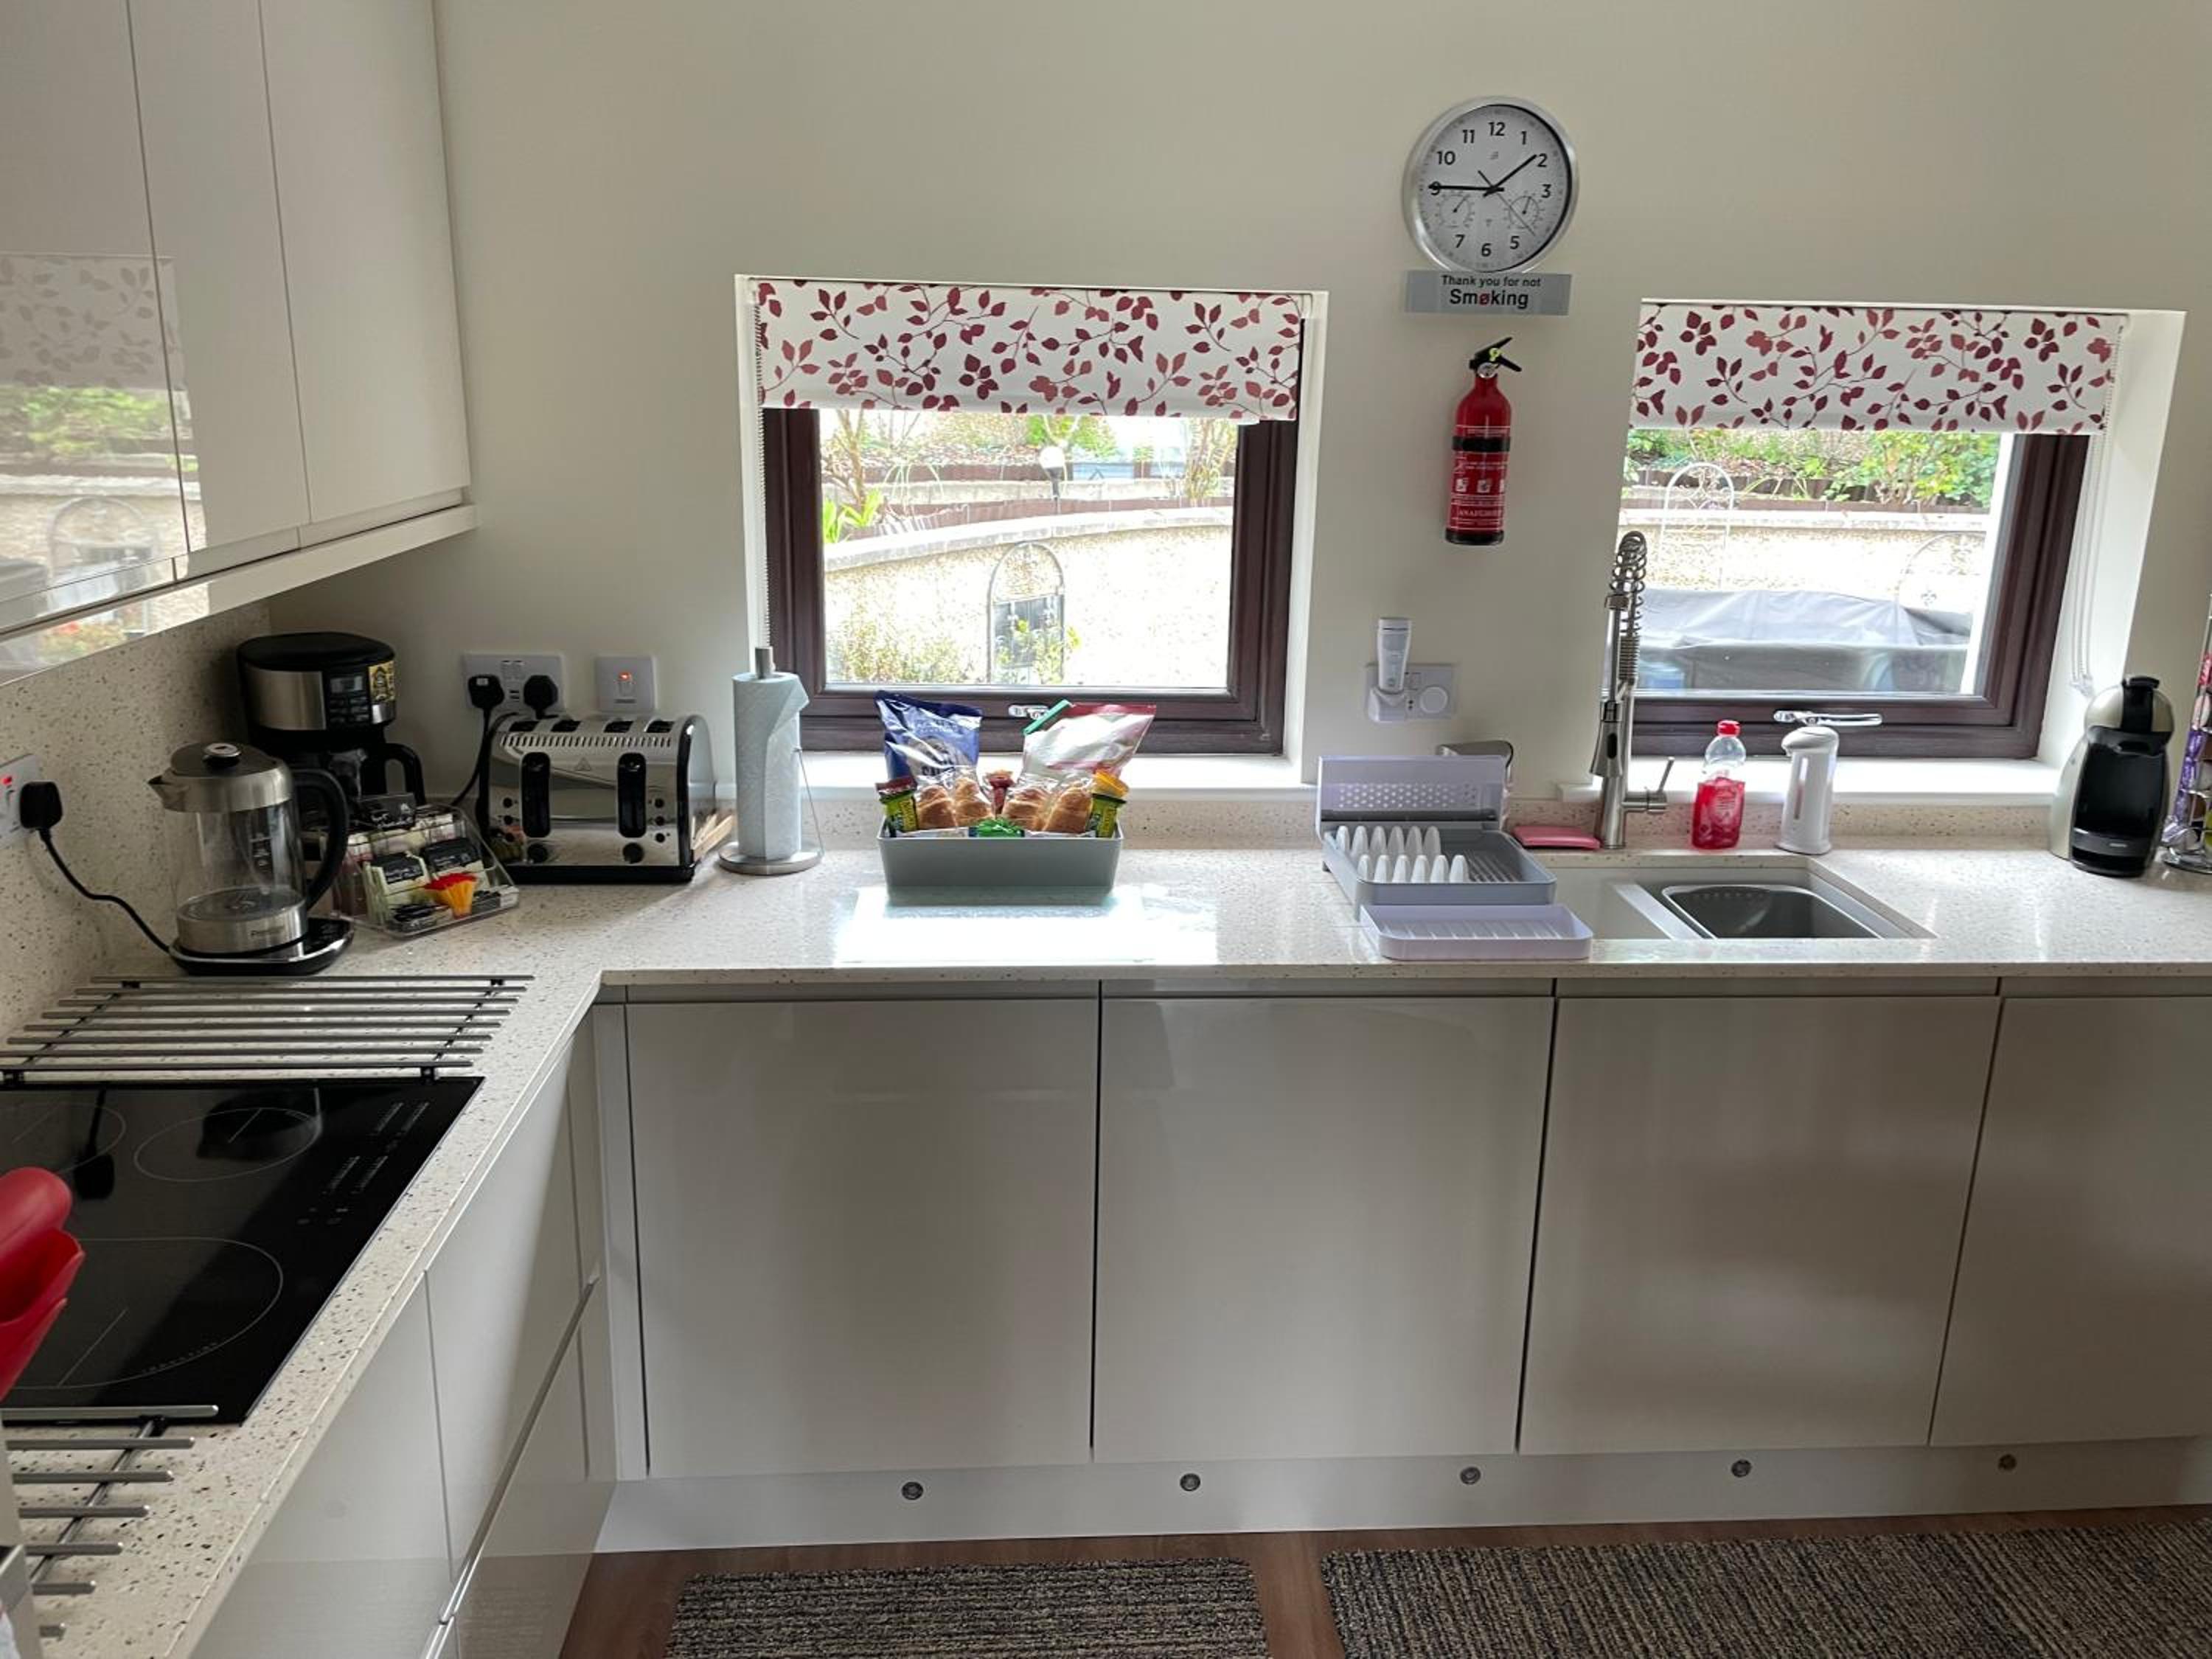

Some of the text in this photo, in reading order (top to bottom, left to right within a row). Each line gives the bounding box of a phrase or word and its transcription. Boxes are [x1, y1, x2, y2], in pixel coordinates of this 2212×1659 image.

[1462, 129, 1475, 144] 11
[1488, 122, 1506, 137] 12
[1520, 131, 1527, 145] 1
[1437, 150, 1455, 166] 10
[1537, 153, 1548, 167] 2
[1541, 184, 1551, 198] 3
[1455, 234, 1465, 248] 7
[1510, 235, 1520, 250] 5
[1481, 243, 1492, 257] 6
[1441, 274, 1542, 288] Thank you for not
